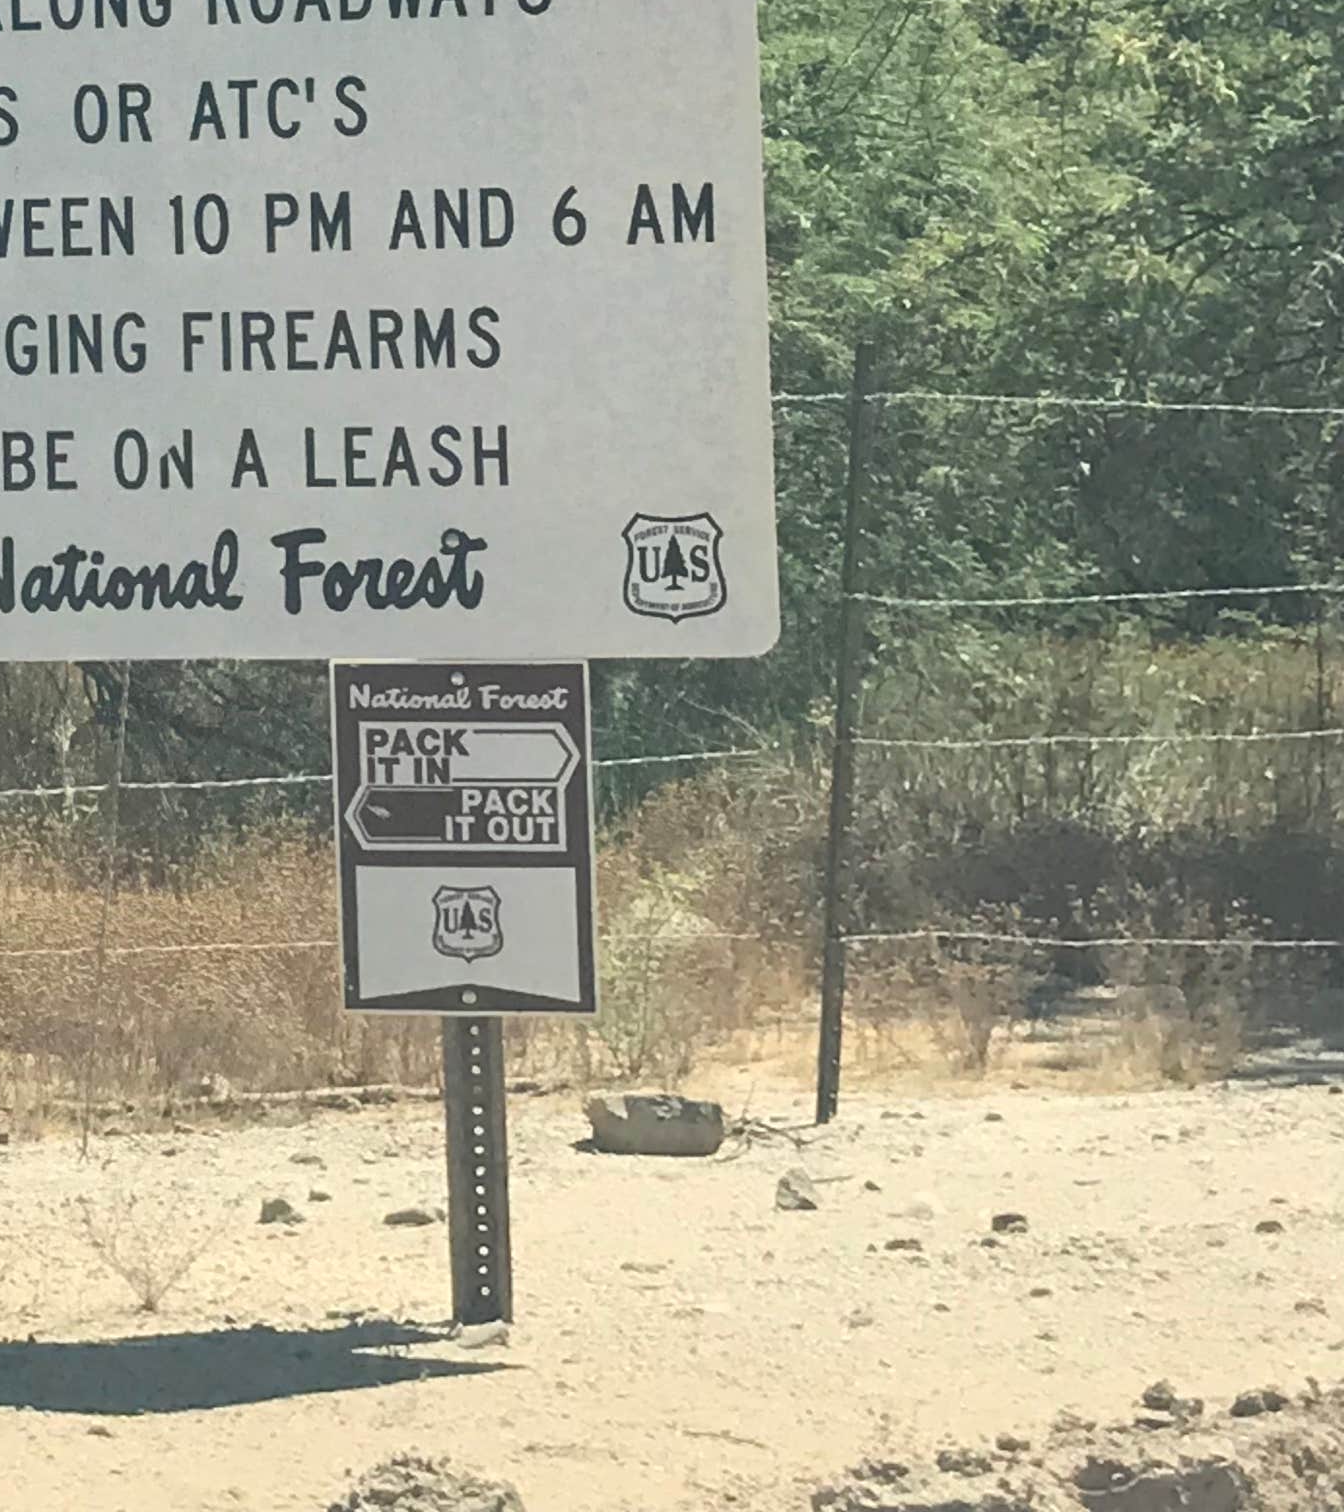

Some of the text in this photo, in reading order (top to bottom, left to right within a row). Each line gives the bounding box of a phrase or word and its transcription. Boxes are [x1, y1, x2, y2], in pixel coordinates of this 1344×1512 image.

[73, 83, 153, 144] OR
[189, 75, 369, 141] ATC'S
[168, 193, 231, 256] 10
[265, 190, 353, 253] PM
[388, 188, 515, 250] AND
[552, 186, 588, 247] 6
[626, 182, 716, 246] AM
[182, 306, 503, 373] FIREARMS
[2, 430, 79, 492] BE
[113, 427, 195, 490] ON
[231, 428, 269, 488] A
[304, 424, 510, 488] LEASH
[270, 527, 488, 615] Forest
[348, 683, 569, 712] National Forest
[365, 728, 470, 757] PACK
[366, 756, 451, 785] IT IN
[461, 788, 554, 815] PACK
[444, 815, 556, 842] IT OUT
